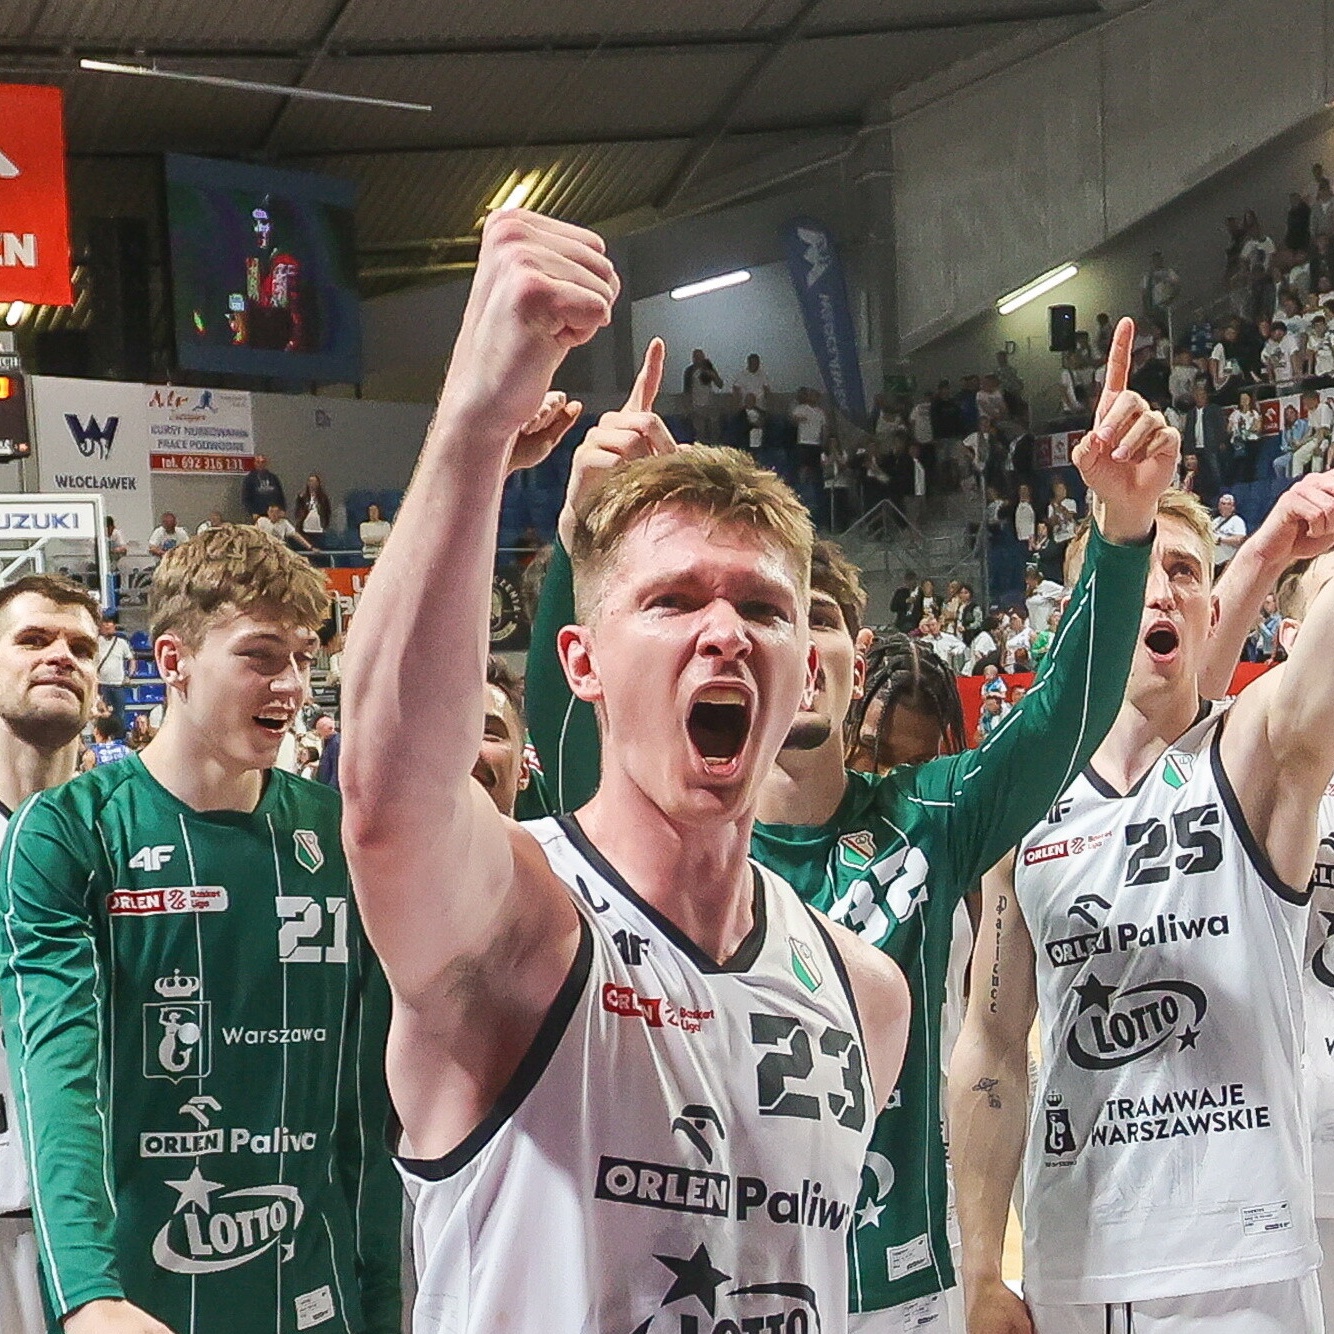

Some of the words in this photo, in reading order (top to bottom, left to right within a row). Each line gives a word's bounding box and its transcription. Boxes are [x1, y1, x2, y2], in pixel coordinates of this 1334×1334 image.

[54, 474, 137, 490] WŁOCŁAWEK
[128, 845, 175, 872] 4F
[1025, 844, 1066, 863] ORLEN
[1125, 803, 1224, 887] 25
[110, 893, 161, 910] ORLEN
[275, 896, 349, 962] 21
[1118, 913, 1230, 952] Paliwa
[606, 990, 653, 1022] ORLN
[679, 1007, 715, 1019] Basket
[222, 1025, 327, 1045] Warszawa
[679, 1019, 703, 1033] Liga
[1090, 996, 1180, 1054] LOTTO
[749, 1012, 866, 1133] 23
[1105, 1084, 1246, 1121] TRAMWAJE
[144, 1135, 219, 1154] ORLEN
[230, 1128, 317, 1154] Paliwa
[1091, 1106, 1271, 1148] WARSZAWSKIE
[604, 1163, 729, 1212] ORLEN
[736, 1177, 851, 1230] Paliw
[185, 1201, 289, 1258] LOTTO
